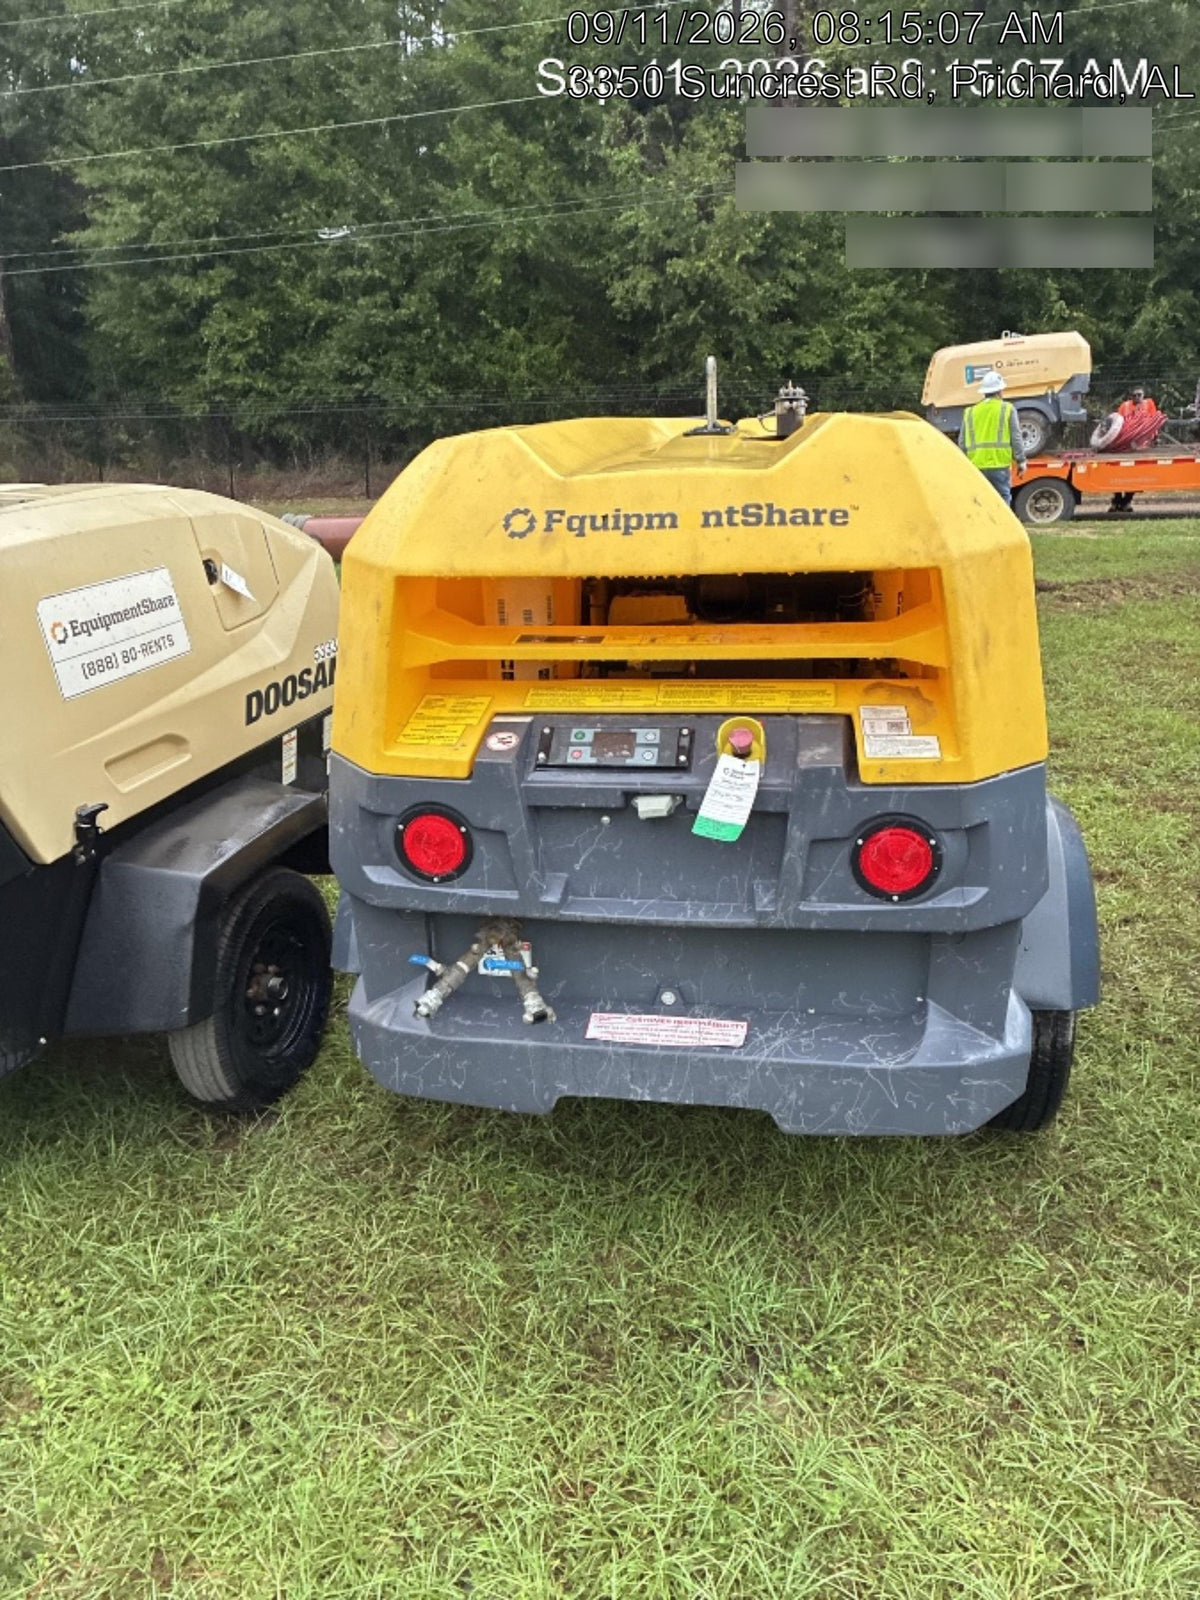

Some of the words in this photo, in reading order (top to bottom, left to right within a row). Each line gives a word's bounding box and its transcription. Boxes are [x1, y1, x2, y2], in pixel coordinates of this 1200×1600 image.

[69, 595, 175, 637] EquipmentShare
[81, 652, 119, 680] (888)
[121, 634, 175, 665] 80-RENTS
